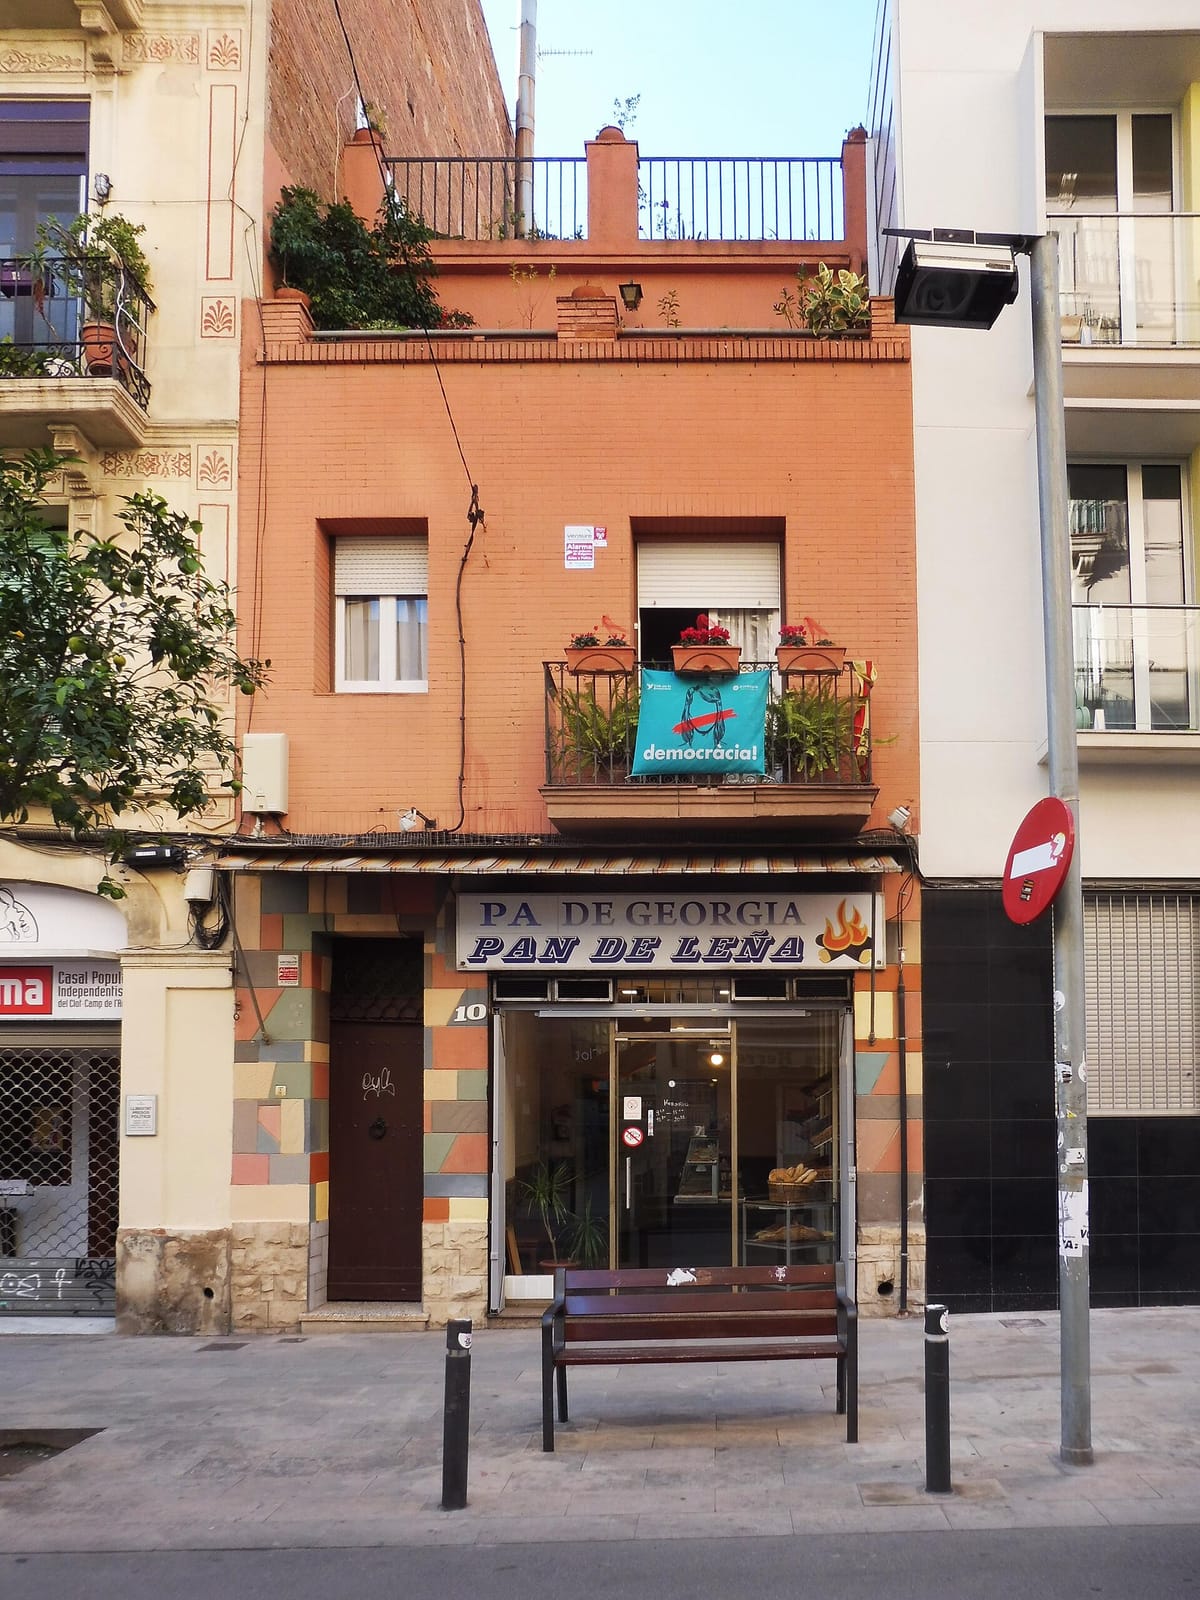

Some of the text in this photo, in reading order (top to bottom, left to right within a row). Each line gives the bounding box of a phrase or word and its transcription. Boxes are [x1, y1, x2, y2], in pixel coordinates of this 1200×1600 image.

[643, 744, 758, 761] democràcia!
[479, 901, 806, 927] PA DE GEORGIA
[466, 928, 805, 964] PAN DE LEÑA
[58, 971, 123, 987] Casal Popul
[58, 999, 69, 1008] del
[104, 999, 112, 1008] de
[453, 1003, 487, 1023] 10
